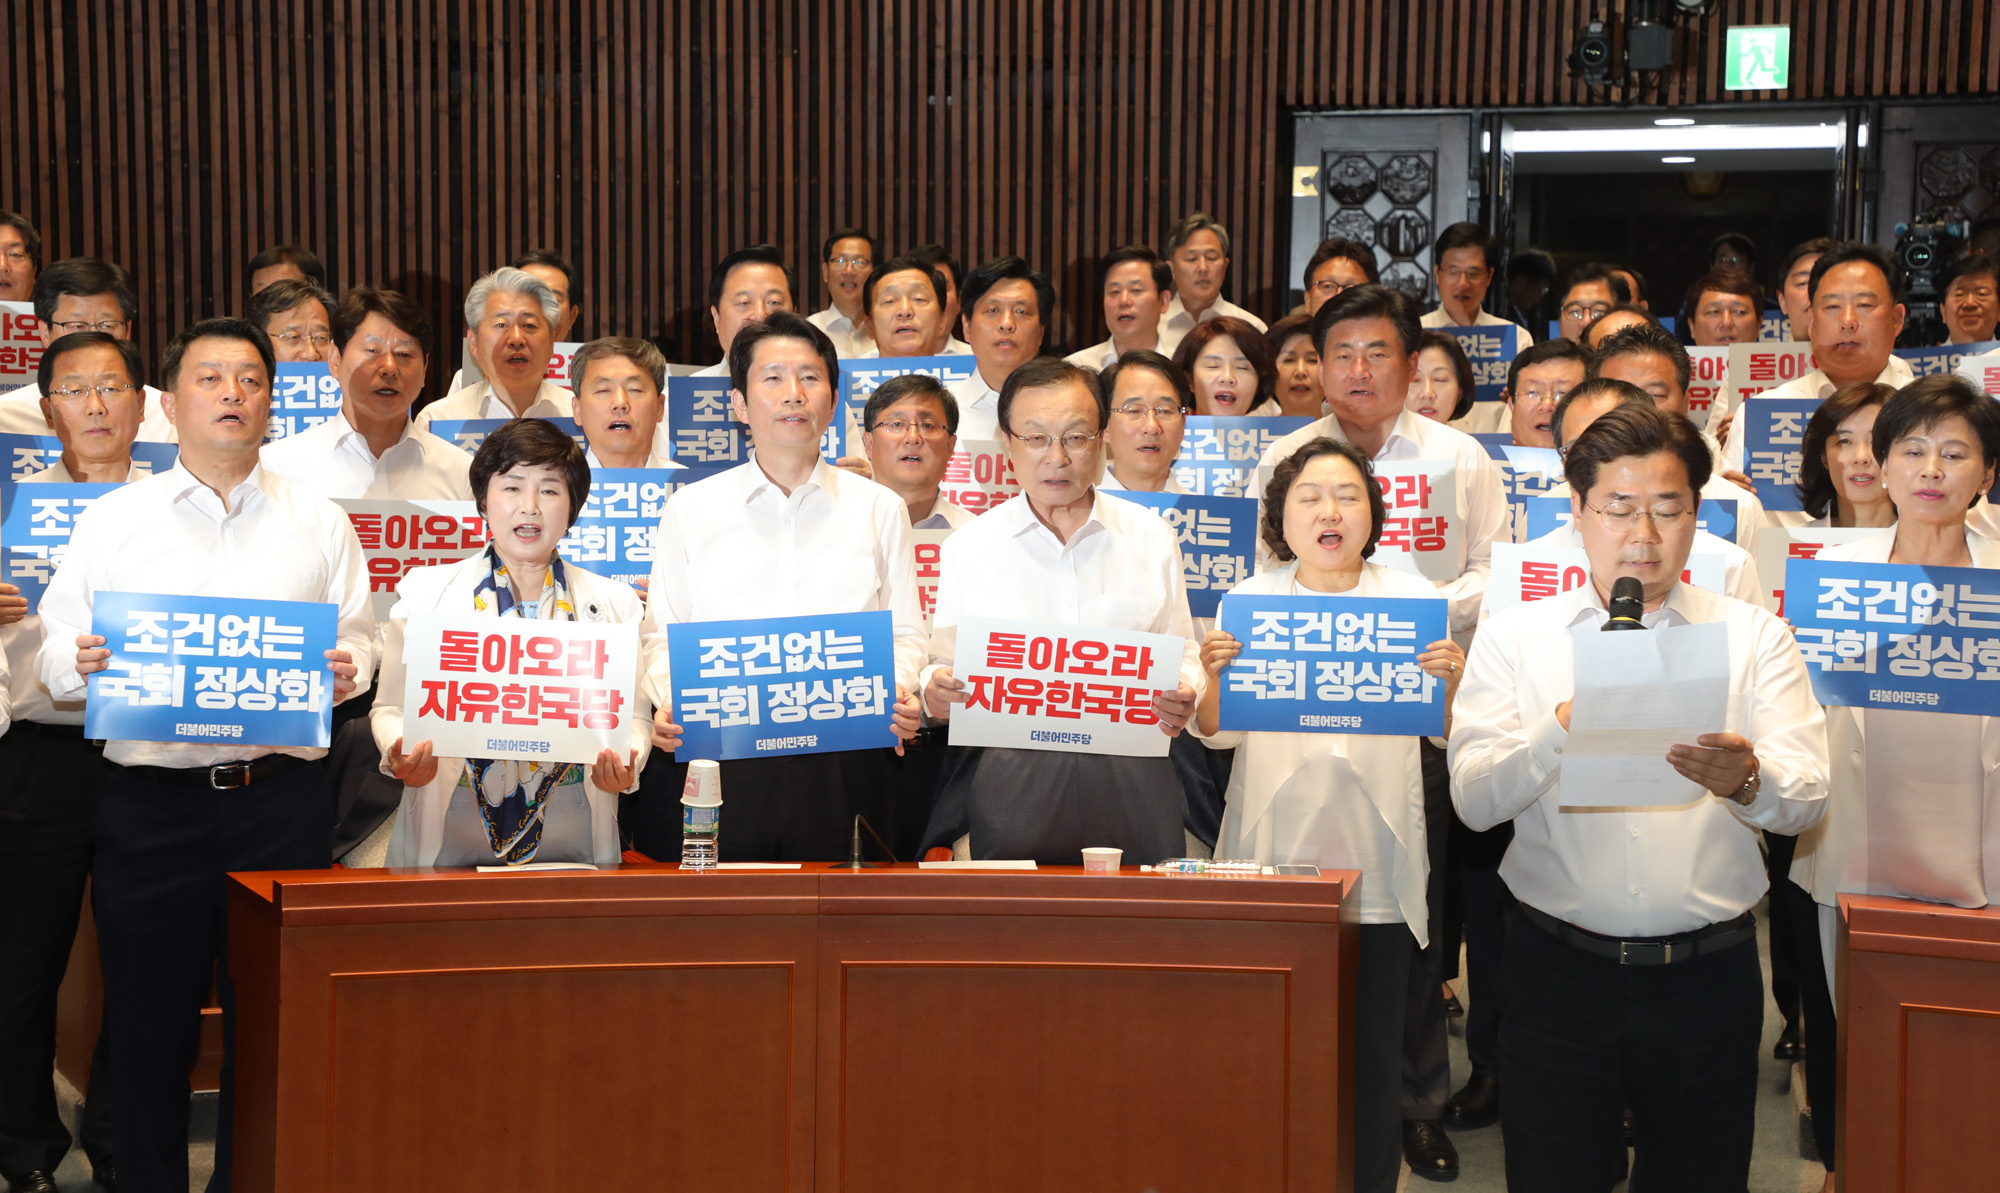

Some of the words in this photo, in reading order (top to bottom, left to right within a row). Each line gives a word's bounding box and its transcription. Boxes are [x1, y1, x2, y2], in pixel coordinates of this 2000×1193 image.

[676, 429, 738, 462] 국회
[1816, 578, 2000, 629] 조건없는
[124, 610, 304, 660] 조건없는
[439, 629, 609, 680] 돌아오라
[699, 629, 864, 679] 조건없는
[986, 631, 1154, 681] 돌아오라
[1250, 611, 1417, 654] 조건없는
[1795, 627, 1878, 674] 국회
[98, 662, 186, 708] 국회
[194, 666, 325, 713] 정상화
[418, 680, 624, 730] 자유한국당
[680, 685, 760, 729] 국회
[767, 675, 889, 724] 정상화
[965, 674, 1163, 726] 자유한국당
[1228, 659, 1306, 700] 국회
[1315, 661, 1437, 704] 정상화
[1869, 689, 1940, 706] 더불어민주당
[175, 723, 244, 738] 더불어민주당
[756, 734, 818, 751] 더불어민주당
[1030, 729, 1092, 745] 더불어민주당
[1299, 714, 1363, 728] 더불어민주당
[486, 738, 551, 753] 더불어민주당
